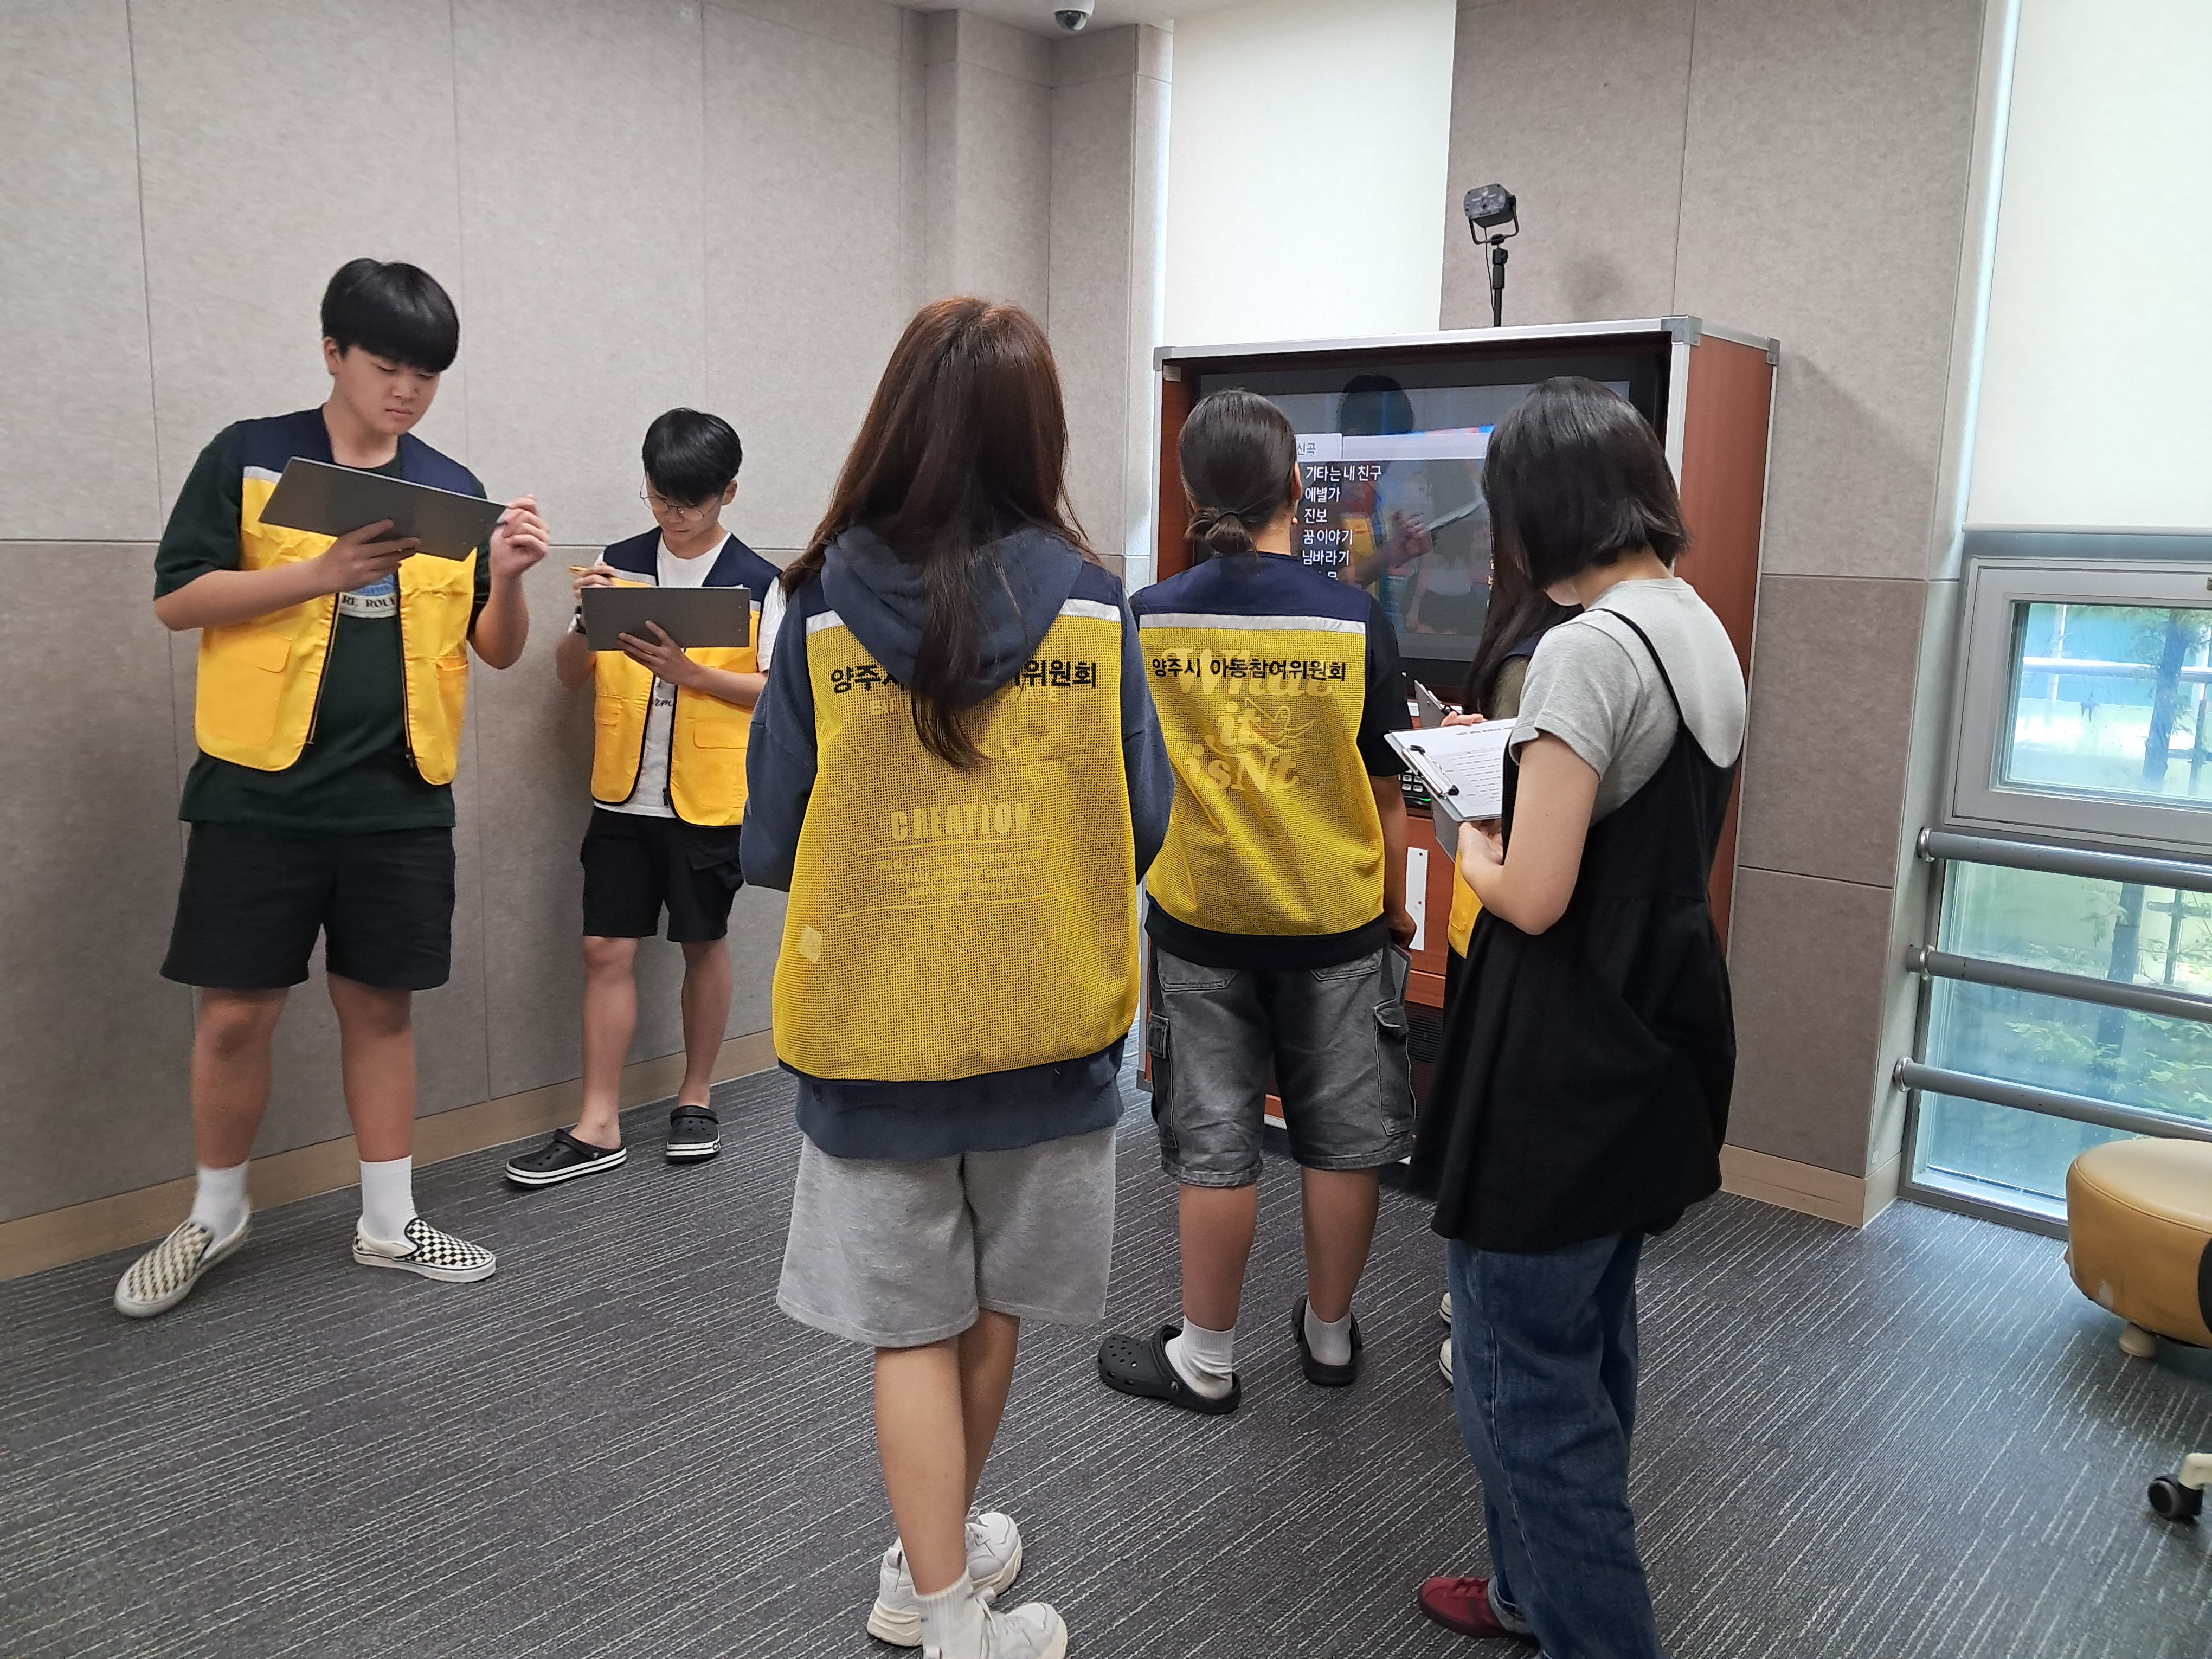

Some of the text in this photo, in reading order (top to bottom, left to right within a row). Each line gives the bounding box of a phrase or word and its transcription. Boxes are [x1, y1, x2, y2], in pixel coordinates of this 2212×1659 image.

[1306, 464, 1382, 482] 기타는 내 친구
[1304, 487, 1341, 503] 애별가
[1304, 507, 1328, 524] 진보
[1303, 529, 1353, 545] 꿈 이야기
[1302, 549, 1349, 567] 님바라기
[1152, 658, 1346, 682] 양주시 아동참여위원회
